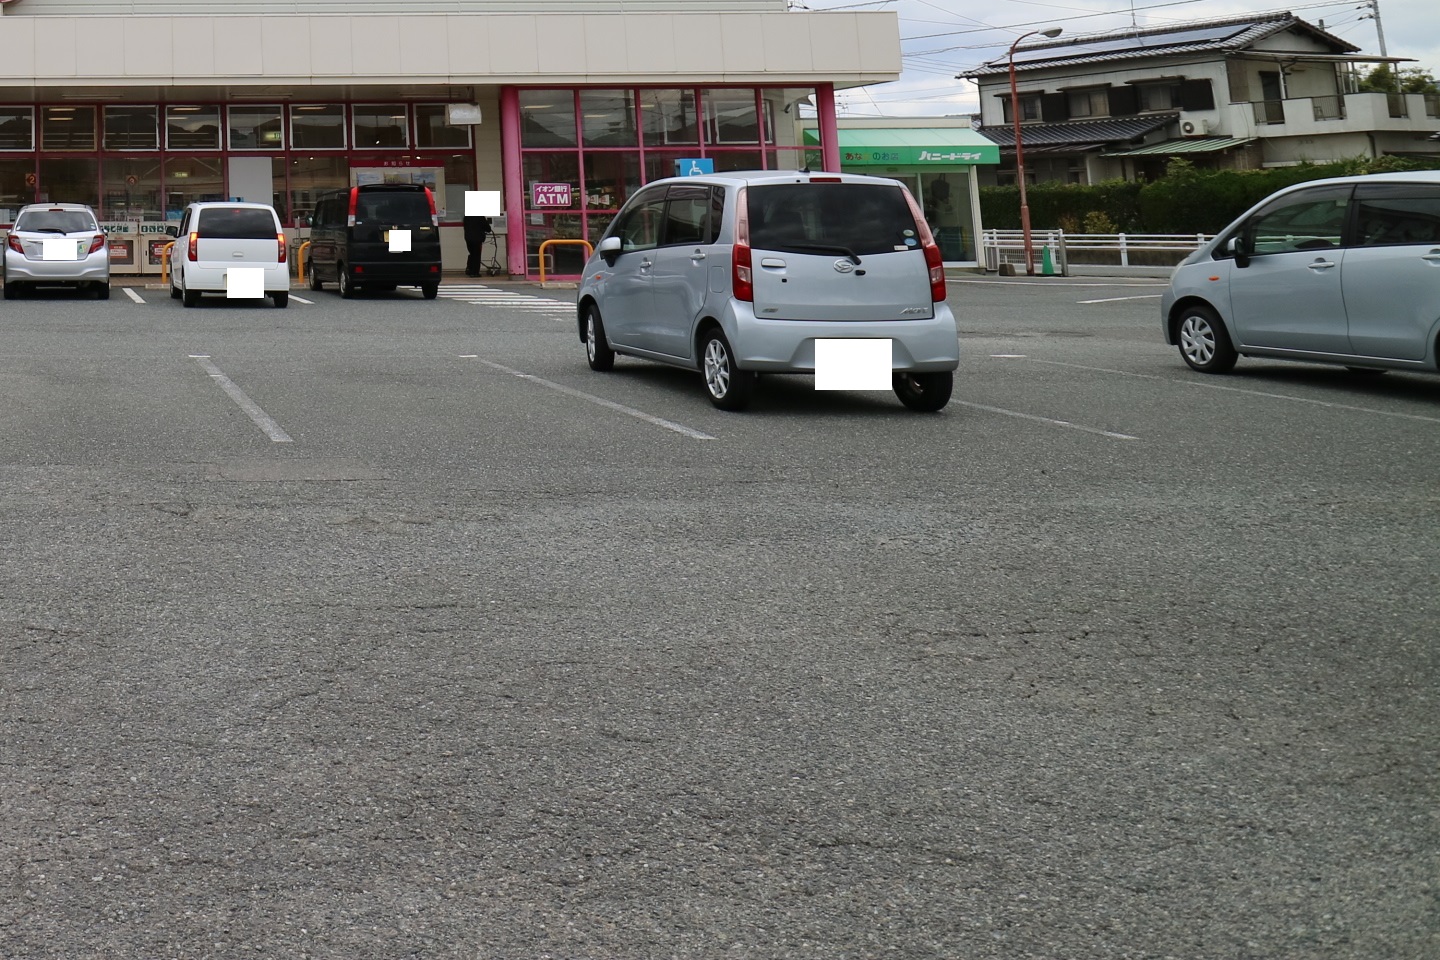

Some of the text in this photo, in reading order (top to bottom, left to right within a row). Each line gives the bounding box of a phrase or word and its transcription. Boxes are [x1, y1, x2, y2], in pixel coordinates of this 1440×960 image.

[918, 150, 982, 161] ハニードライ
[536, 185, 567, 193] イオン銀行
[537, 193, 568, 204] ATM
